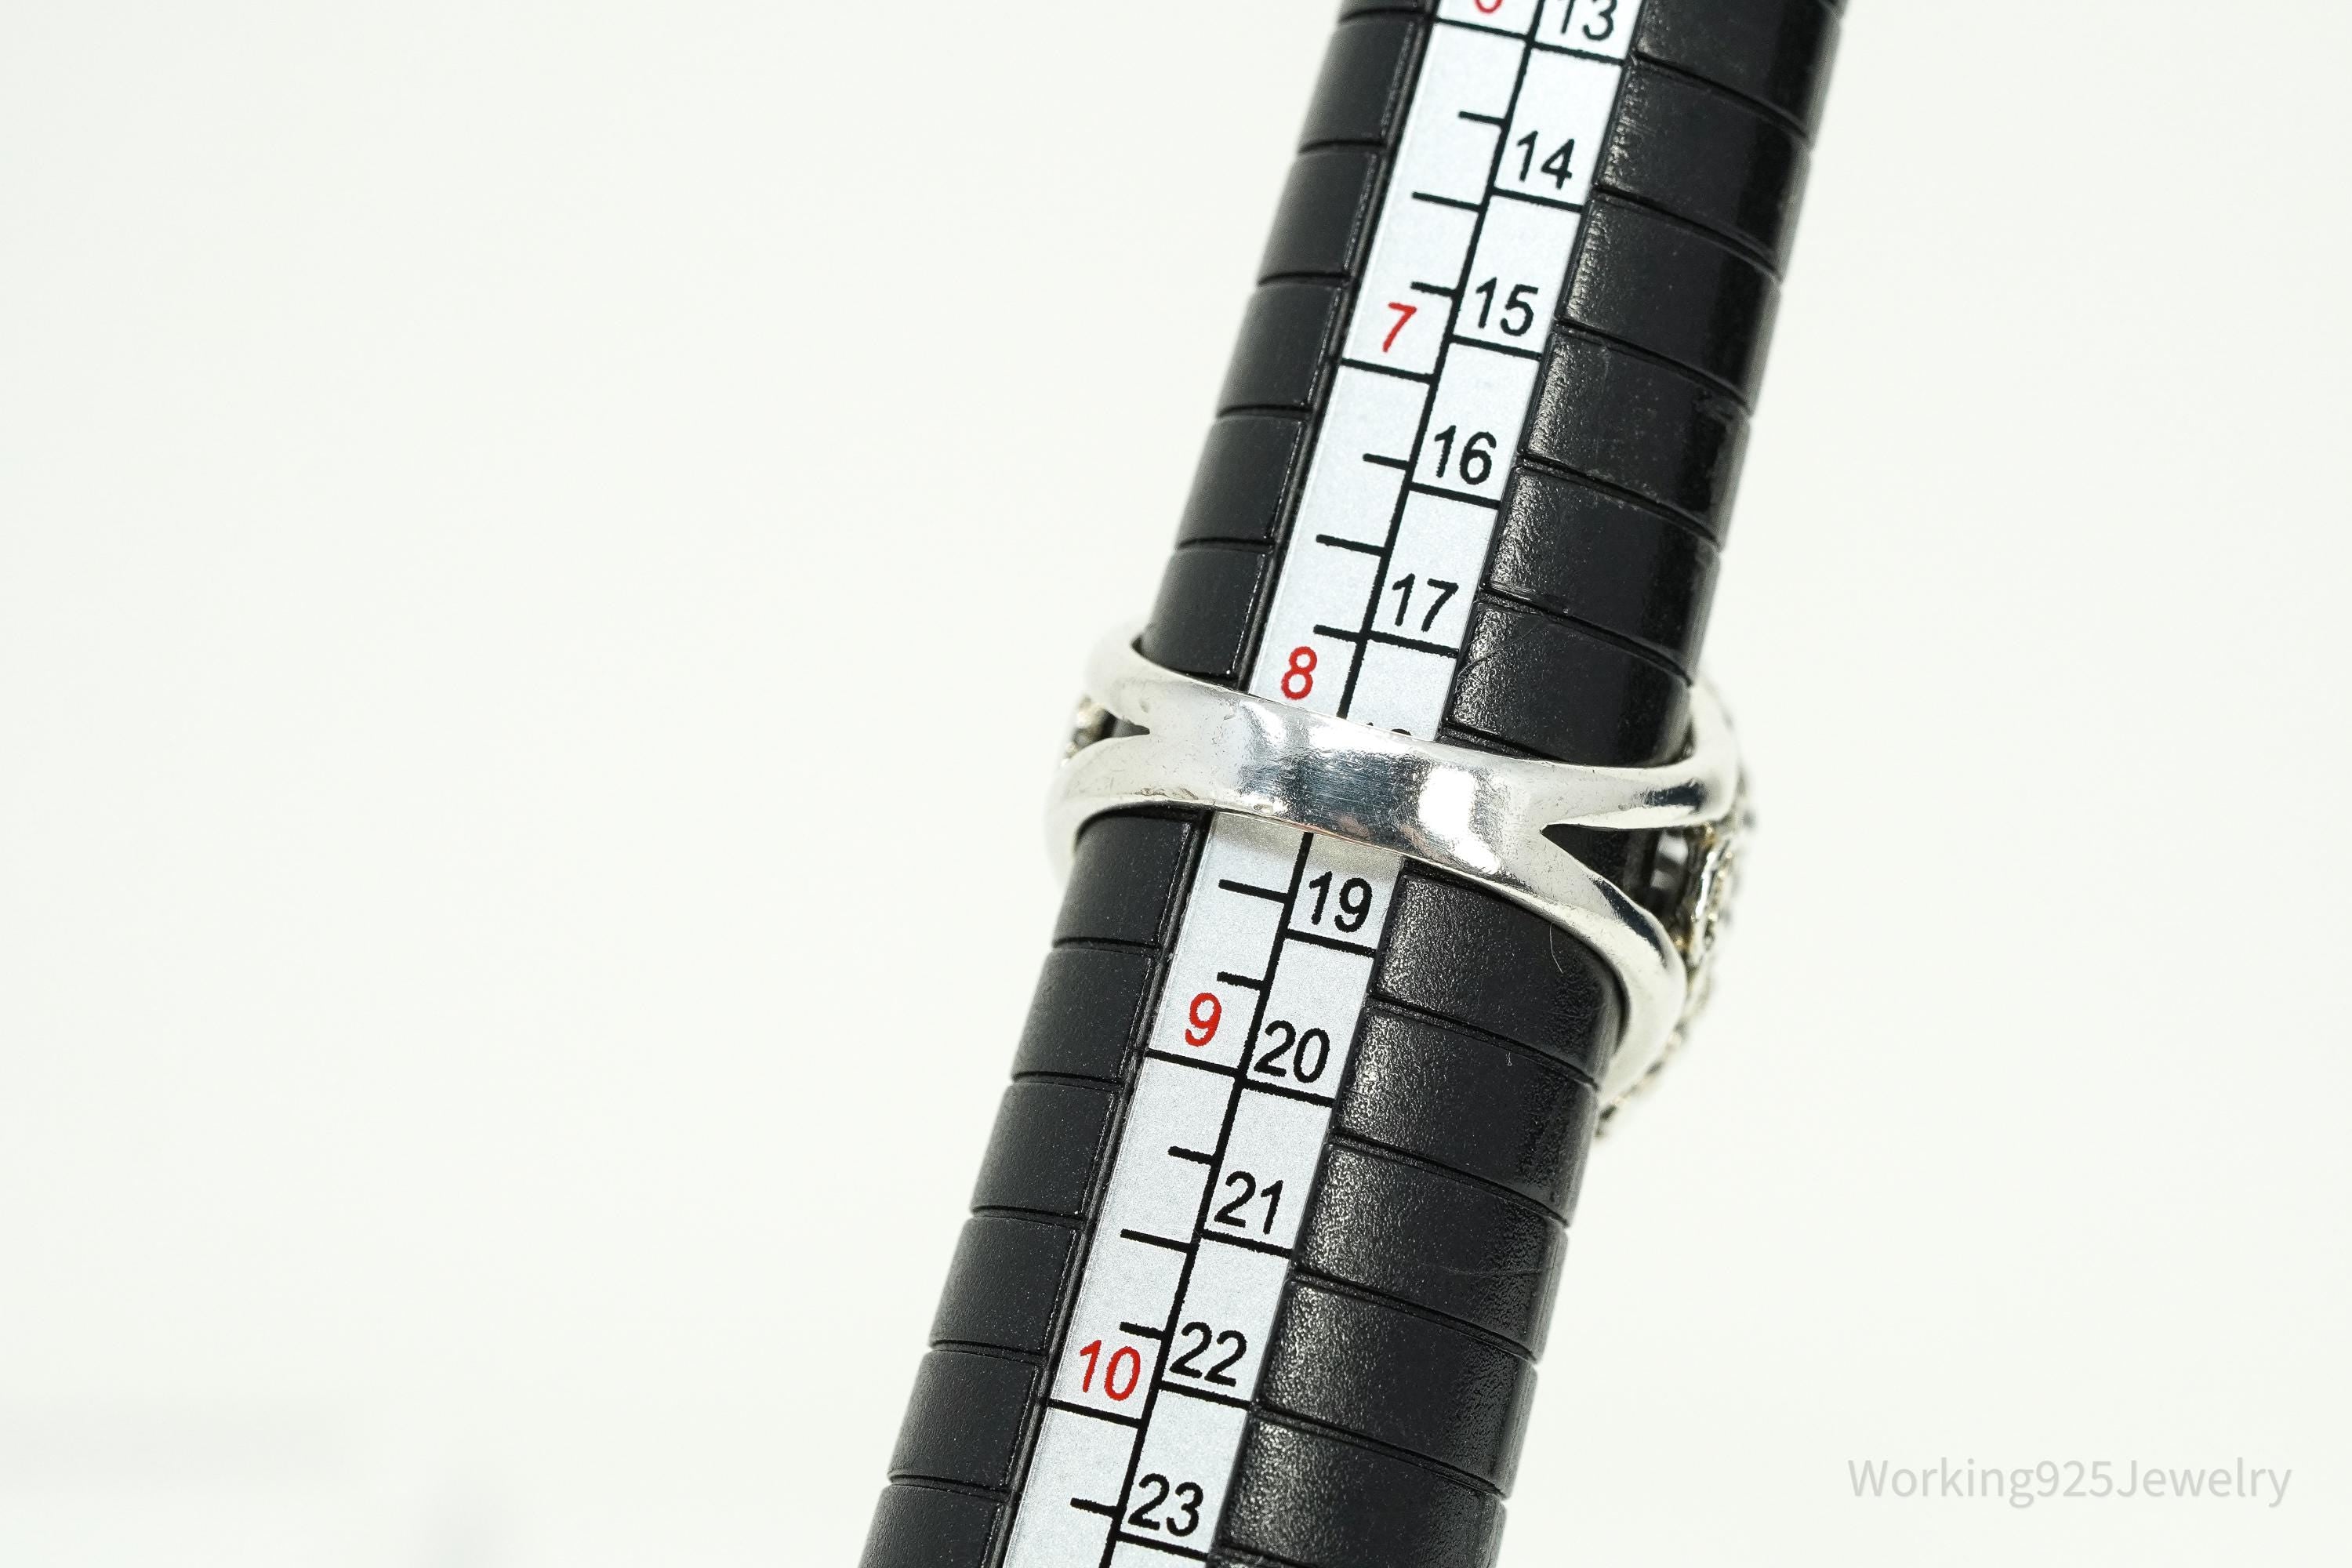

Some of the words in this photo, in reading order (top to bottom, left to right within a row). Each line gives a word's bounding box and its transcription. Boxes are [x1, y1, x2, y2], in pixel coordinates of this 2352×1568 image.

[1557, 0, 1617, 42] 13
[1516, 129, 1576, 190] 14
[1381, 301, 1417, 353] 7
[1475, 276, 1540, 337] 15
[1433, 424, 1497, 486] 16
[1391, 572, 1460, 633] 17
[1280, 645, 1318, 701] 8
[1307, 870, 1374, 934] 19
[1184, 992, 1222, 1047] 9
[1252, 1019, 1331, 1084] 20
[1212, 1170, 1285, 1236] 21
[1078, 1339, 1142, 1402] 10
[1167, 1320, 1249, 1388] 22
[1127, 1472, 1205, 1538] 23
